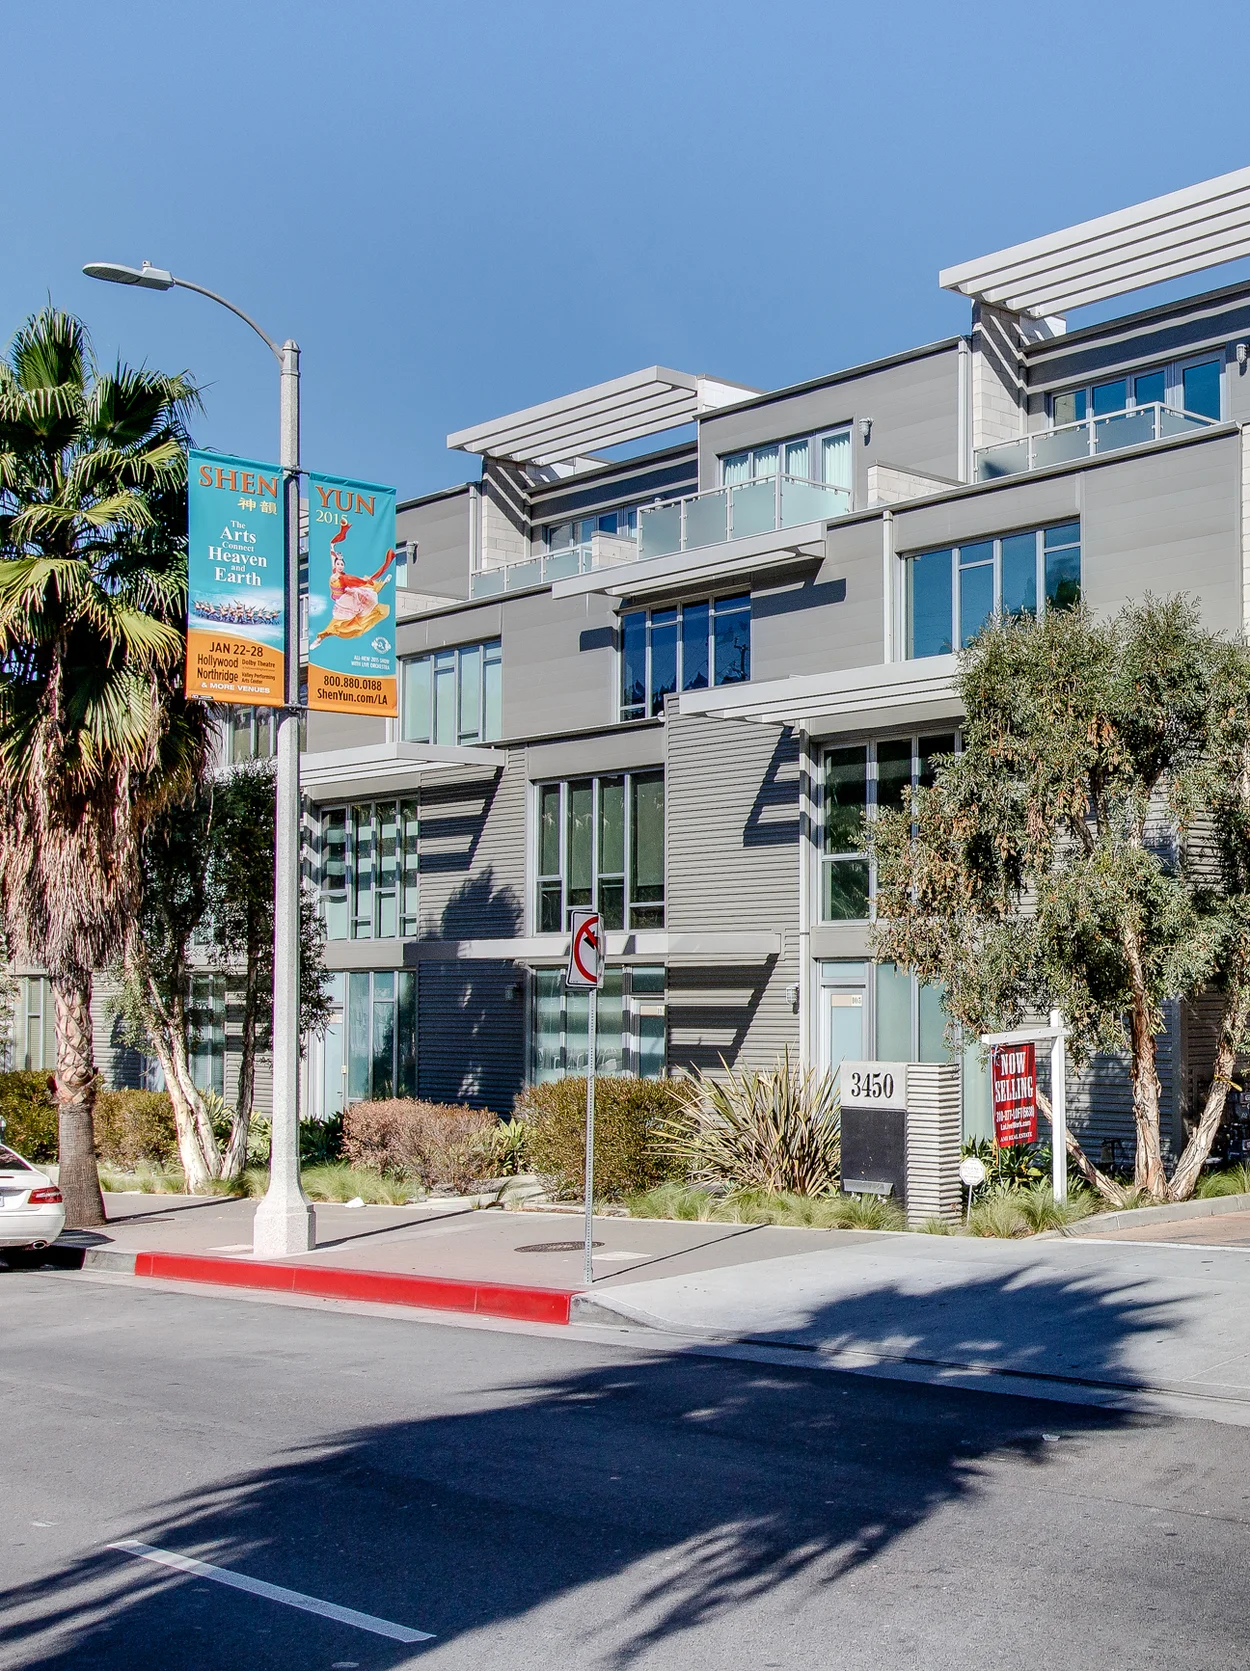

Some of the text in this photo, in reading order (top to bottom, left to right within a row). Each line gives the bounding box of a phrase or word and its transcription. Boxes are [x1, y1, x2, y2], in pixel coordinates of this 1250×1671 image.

[199, 465, 279, 499] SHEN
[237, 497, 278, 516] 神韻
[315, 485, 376, 517] YUN
[230, 520, 246, 529] The
[316, 509, 349, 527] 2015
[220, 526, 257, 544] Arts
[222, 541, 254, 553] Connect
[208, 545, 268, 568] Heaven
[214, 566, 262, 587] Earth
[231, 564, 246, 572] and
[209, 641, 264, 658] JAN 22-28
[197, 653, 239, 669] Hollywood
[241, 659, 276, 668] Dolby Theatre
[197, 667, 239, 683] Northridge
[323, 675, 382, 691] 800.880.0188
[209, 682, 235, 691] MORE
[237, 685, 271, 694] VENUES
[317, 688, 388, 705] ShenYun.com/LA
[1000, 1051, 1026, 1076] NOW
[851, 1072, 894, 1099] 3450
[995, 1076, 1034, 1103] SELLING
